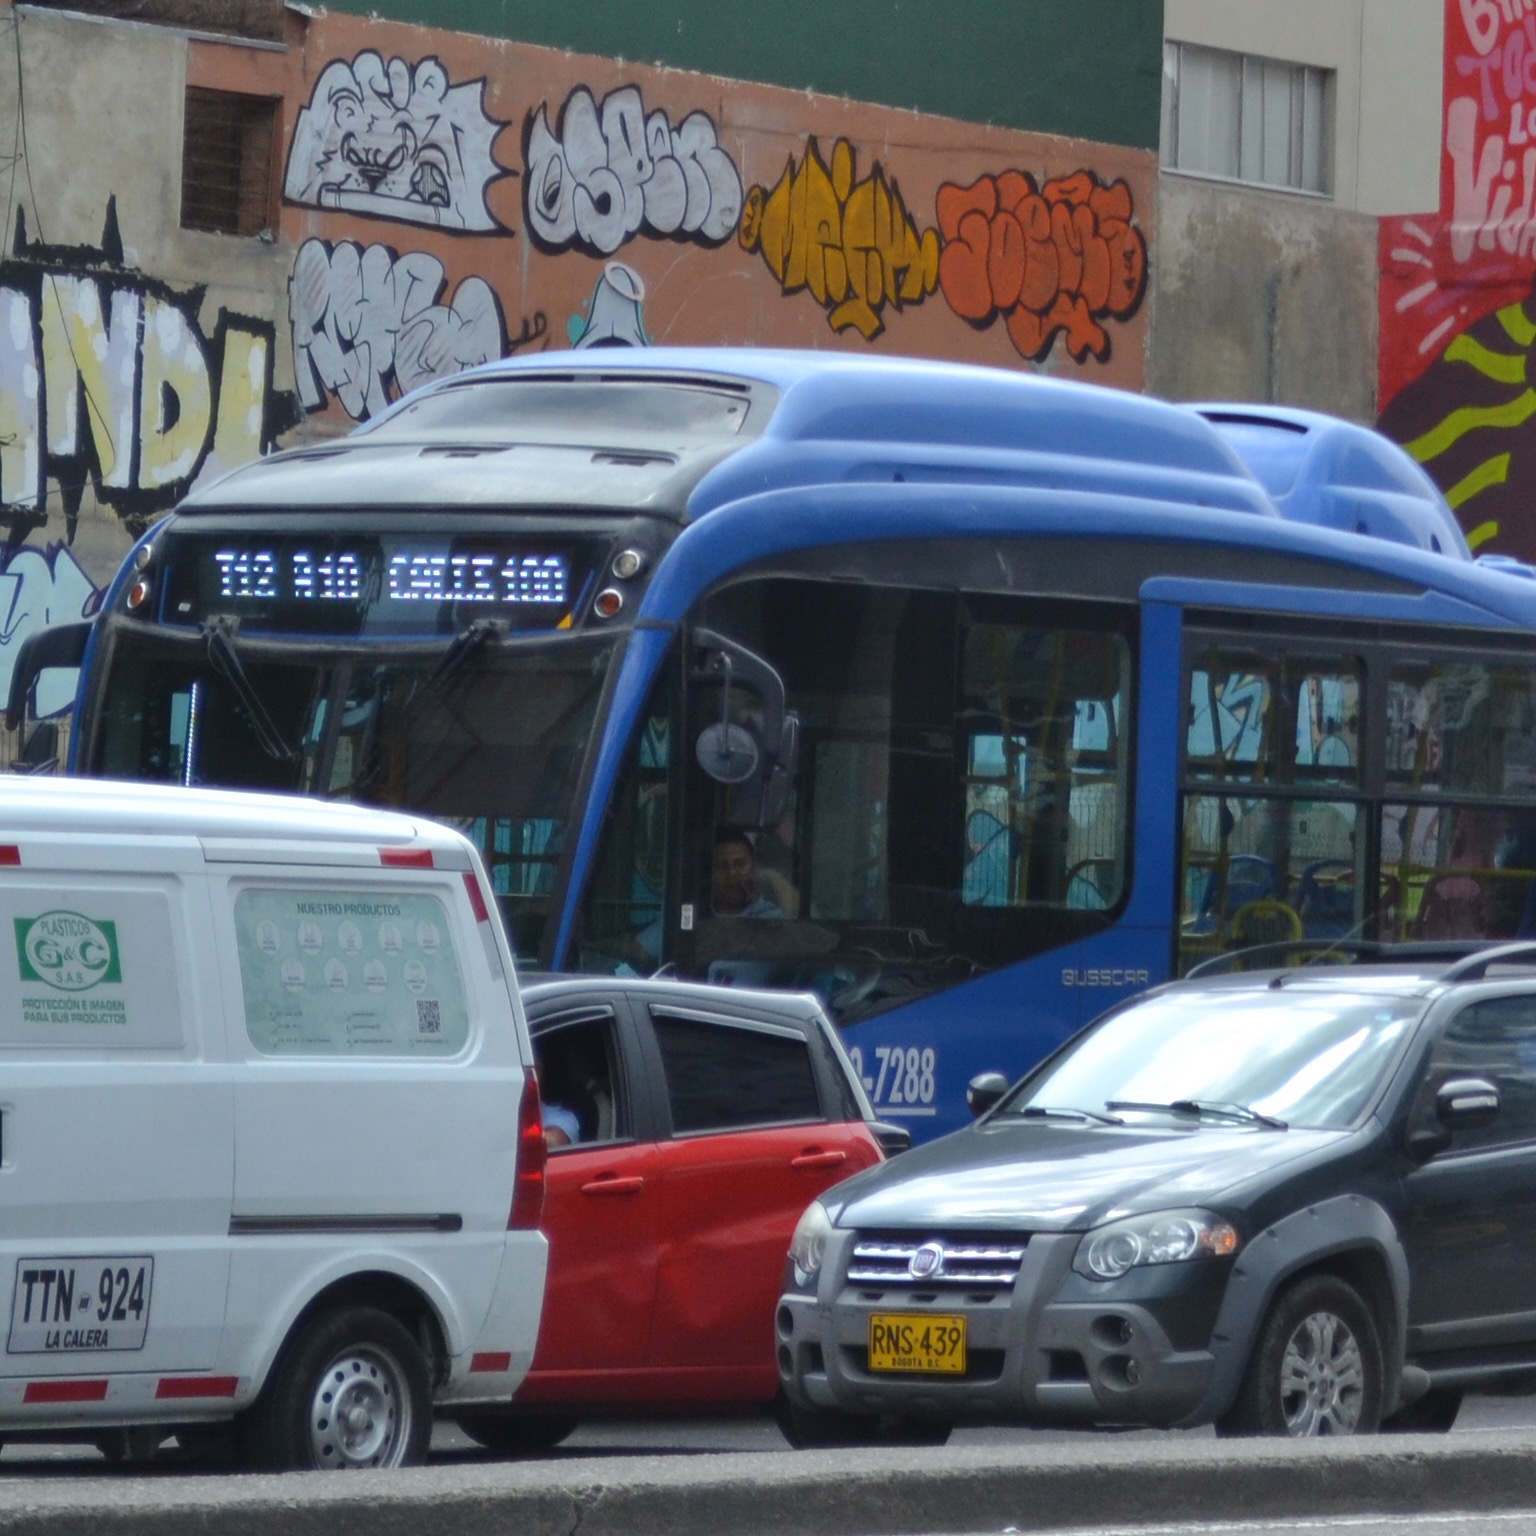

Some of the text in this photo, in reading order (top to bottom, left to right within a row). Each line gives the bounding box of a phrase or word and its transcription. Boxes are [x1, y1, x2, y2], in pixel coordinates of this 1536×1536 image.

[297, 903, 401, 916] NUESTRO PRODUCTOS
[1062, 968, 1149, 986] BUSSCAR
[23, 1012, 127, 1025] PARA SUS PRODUCTOS
[22, 1267, 145, 1323] TTN 924
[45, 1328, 109, 1349] LA CALERA
